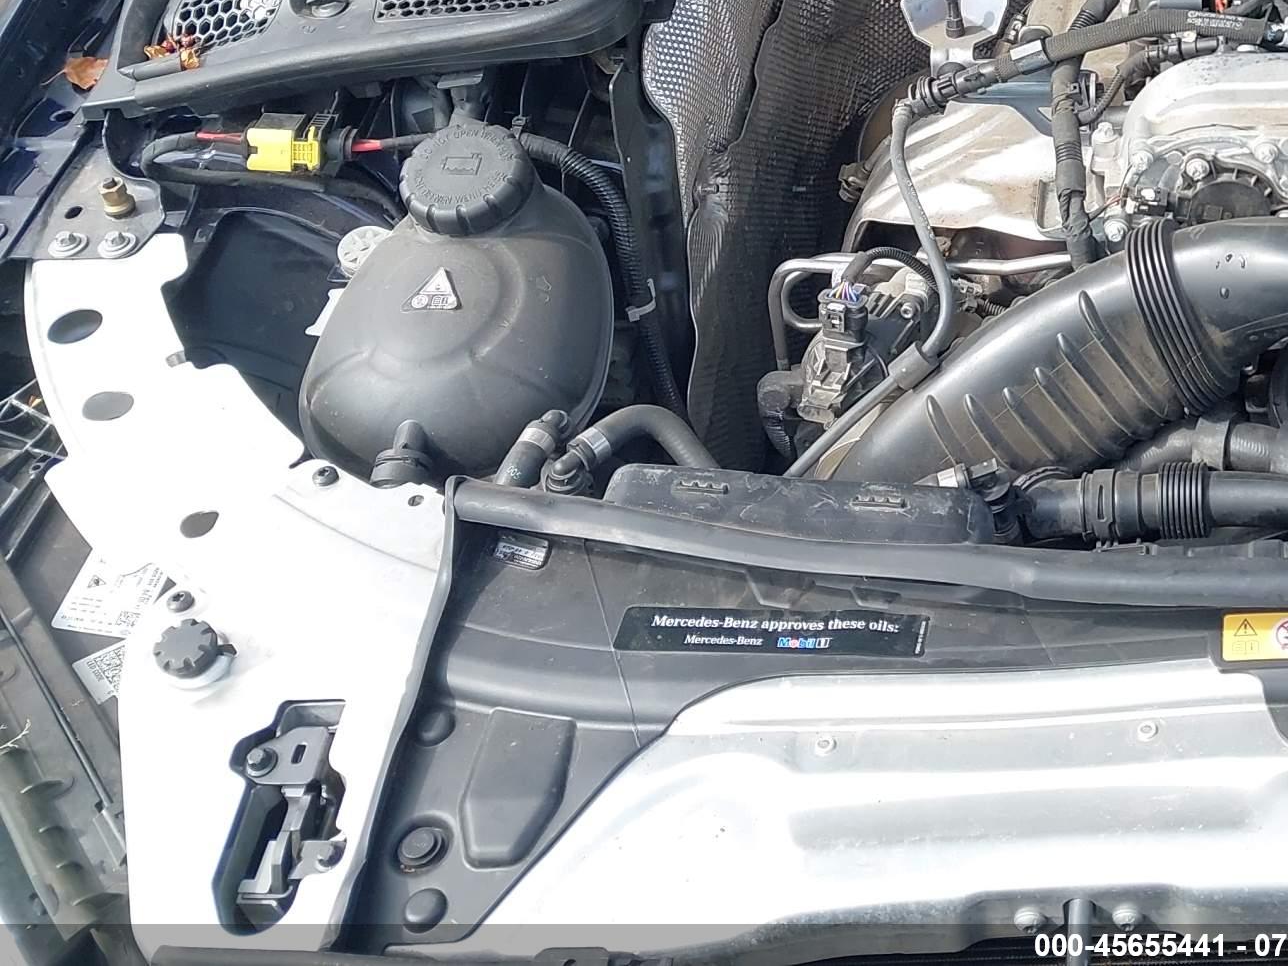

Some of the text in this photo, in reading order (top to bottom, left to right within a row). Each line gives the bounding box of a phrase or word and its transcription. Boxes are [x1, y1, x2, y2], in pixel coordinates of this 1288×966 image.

[651, 615, 900, 633] Mercedes-Benz approves these oils:
[684, 634, 764, 646] Mercedes-Benz
[777, 636, 816, 649] Mobil
